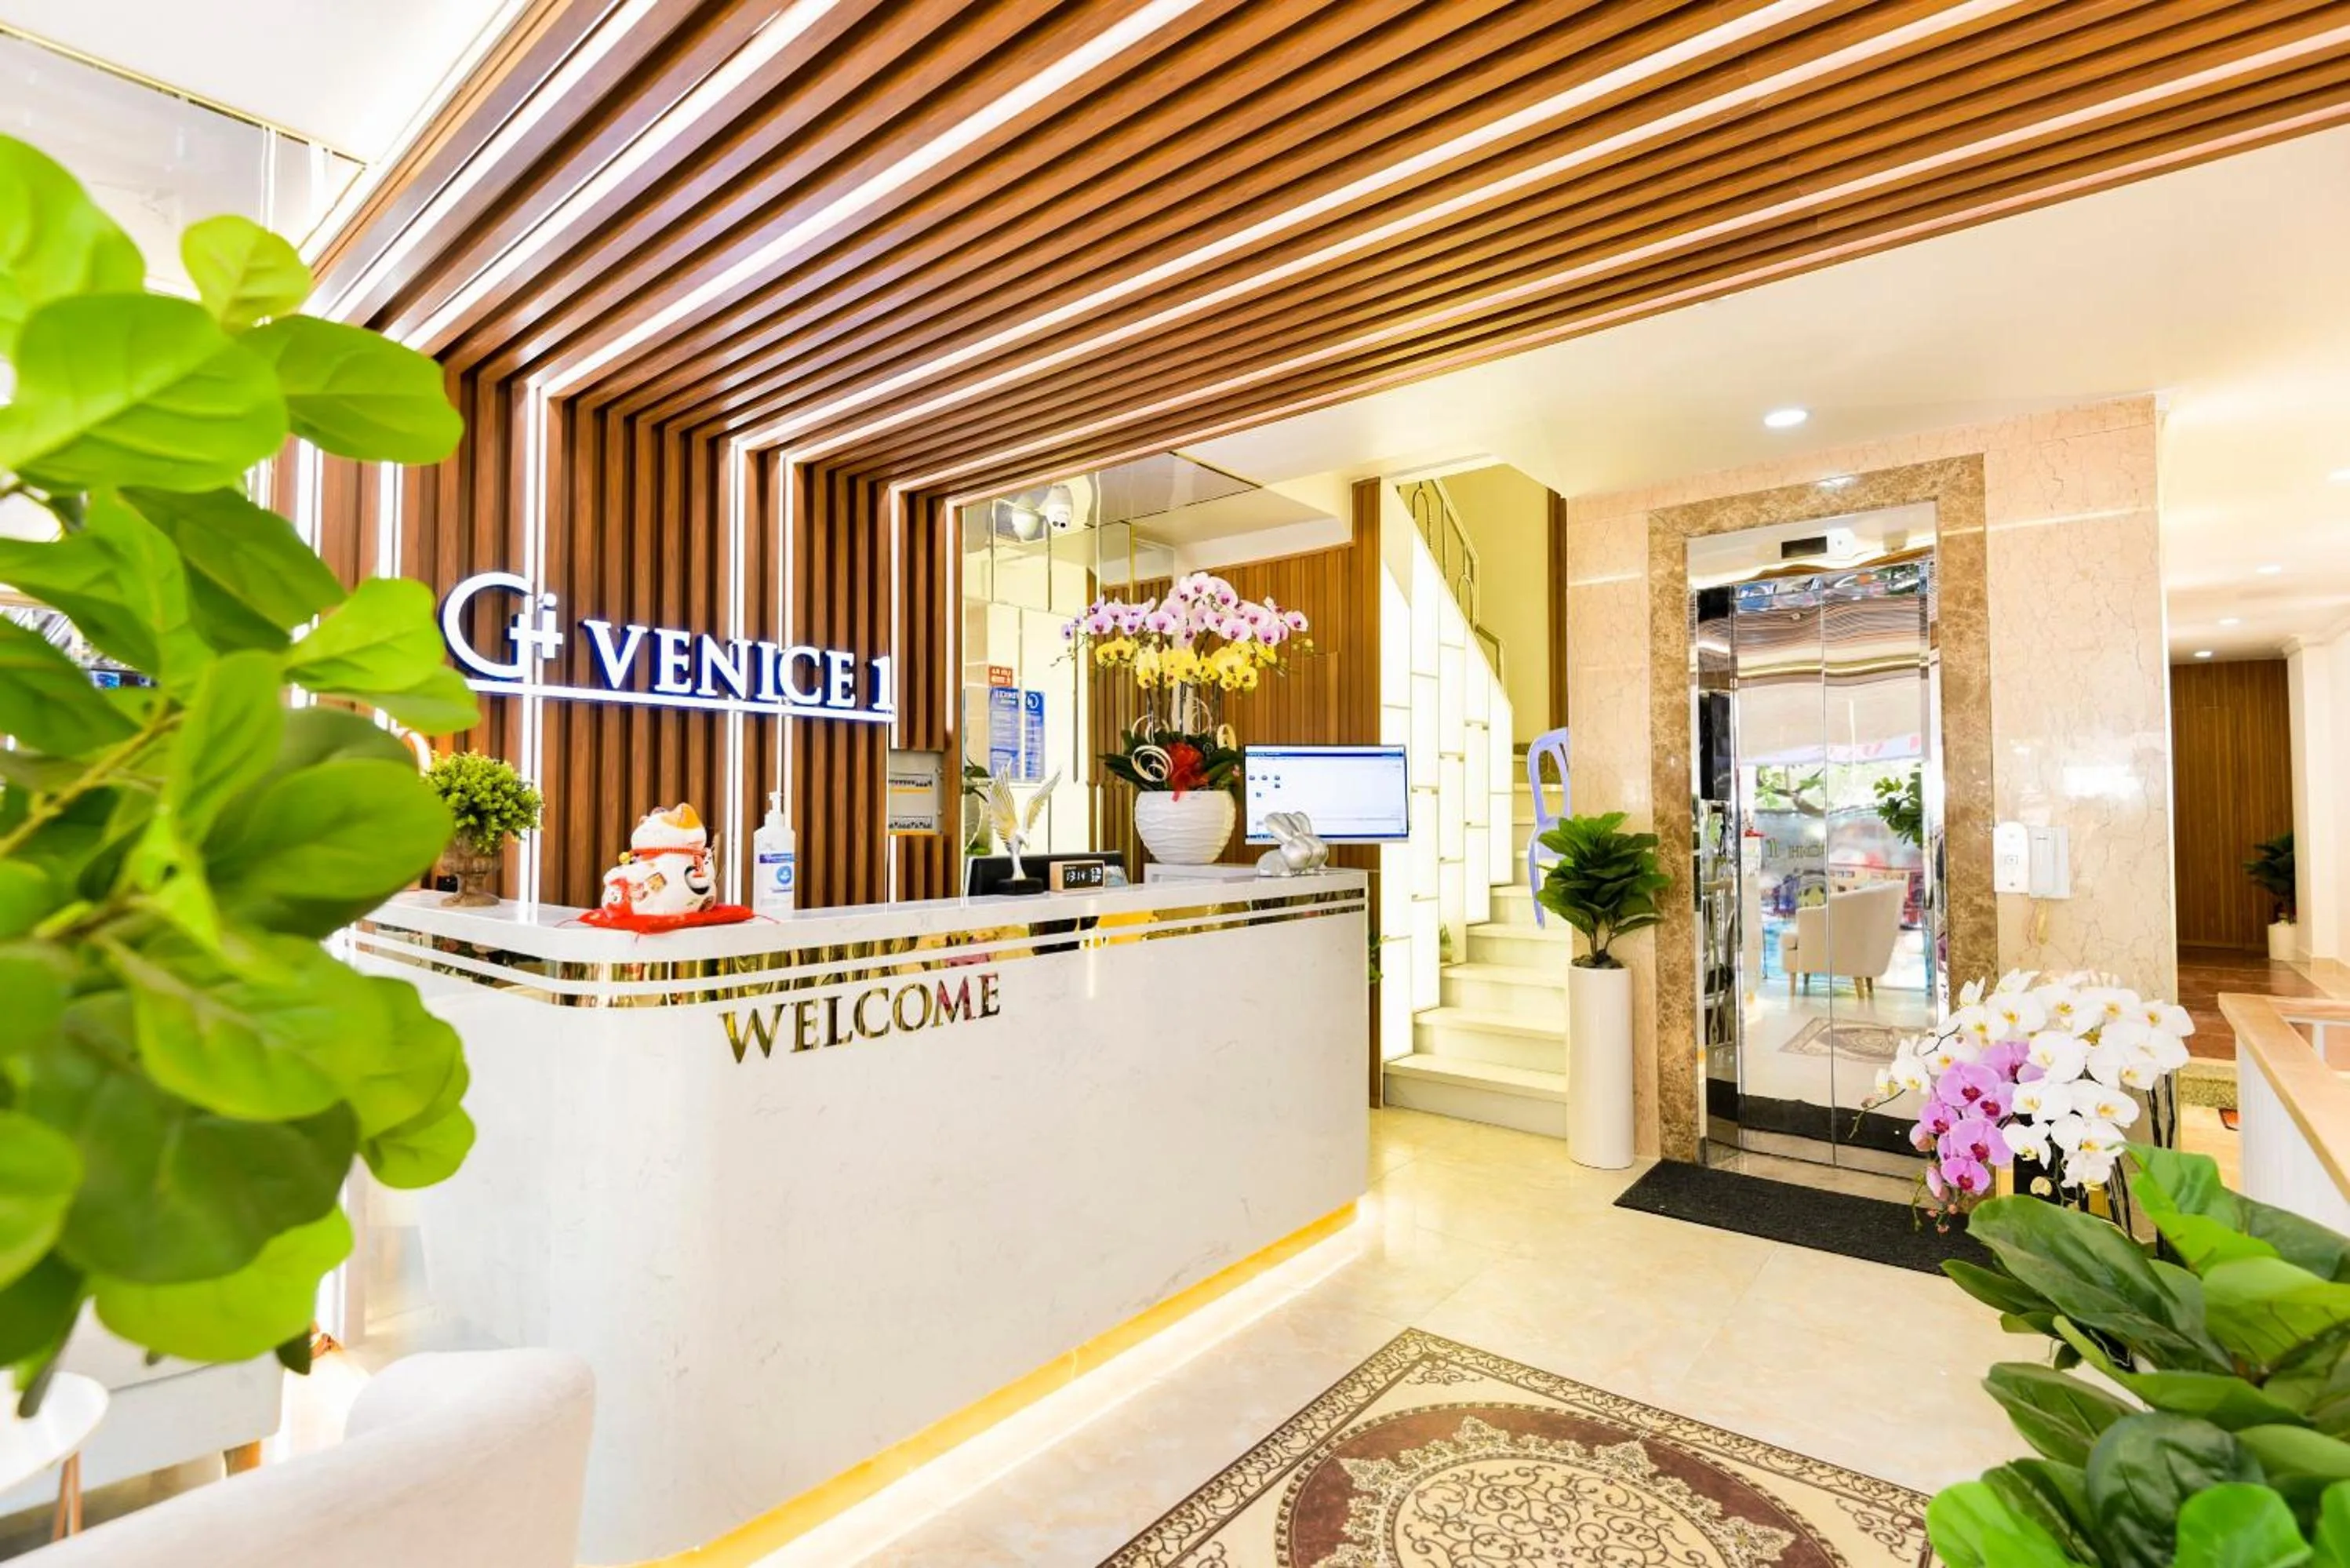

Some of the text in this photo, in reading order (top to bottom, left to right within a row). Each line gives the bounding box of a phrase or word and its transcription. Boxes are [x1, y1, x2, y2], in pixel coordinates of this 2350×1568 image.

[580, 618, 857, 709] VENICE
[867, 655, 891, 711] 1
[718, 972, 1001, 1064] WELCOME
